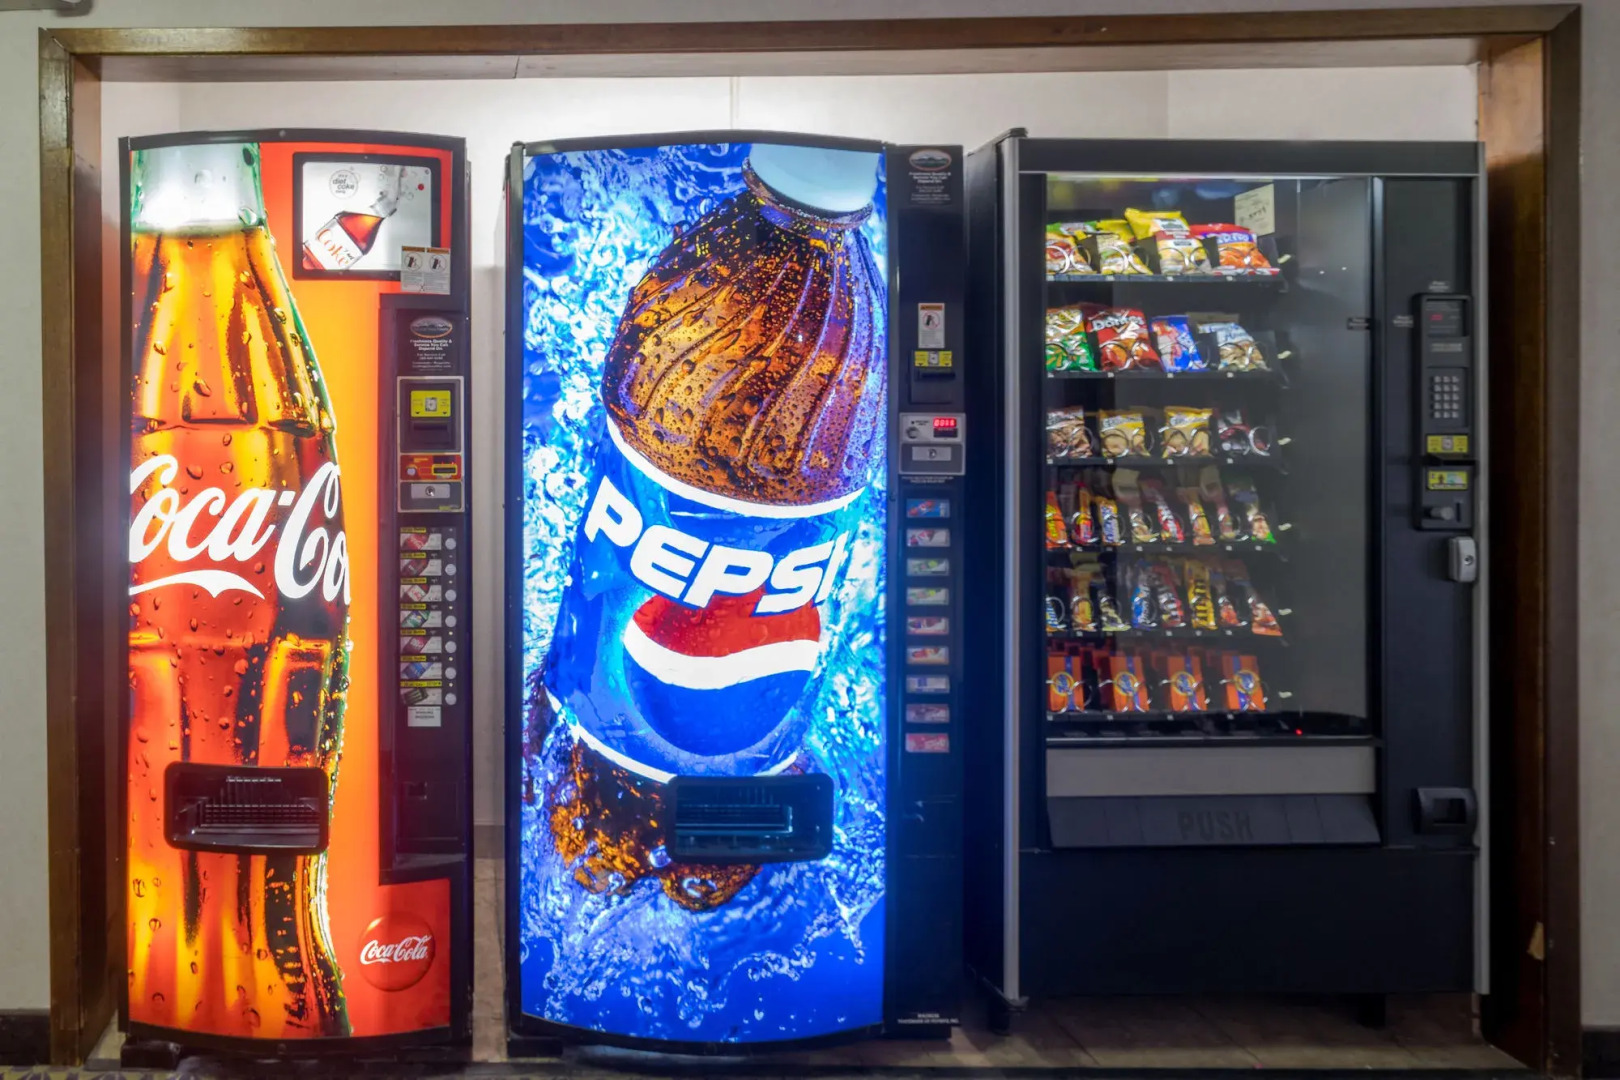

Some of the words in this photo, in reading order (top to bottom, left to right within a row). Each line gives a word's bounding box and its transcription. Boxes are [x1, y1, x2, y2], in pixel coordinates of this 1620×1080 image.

[316, 228, 346, 267] Coke
[1092, 315, 1145, 331] Doritos
[584, 475, 849, 614] PEPSI
[1177, 810, 1255, 842] PUSH
[360, 935, 432, 965] Coca-Cola
